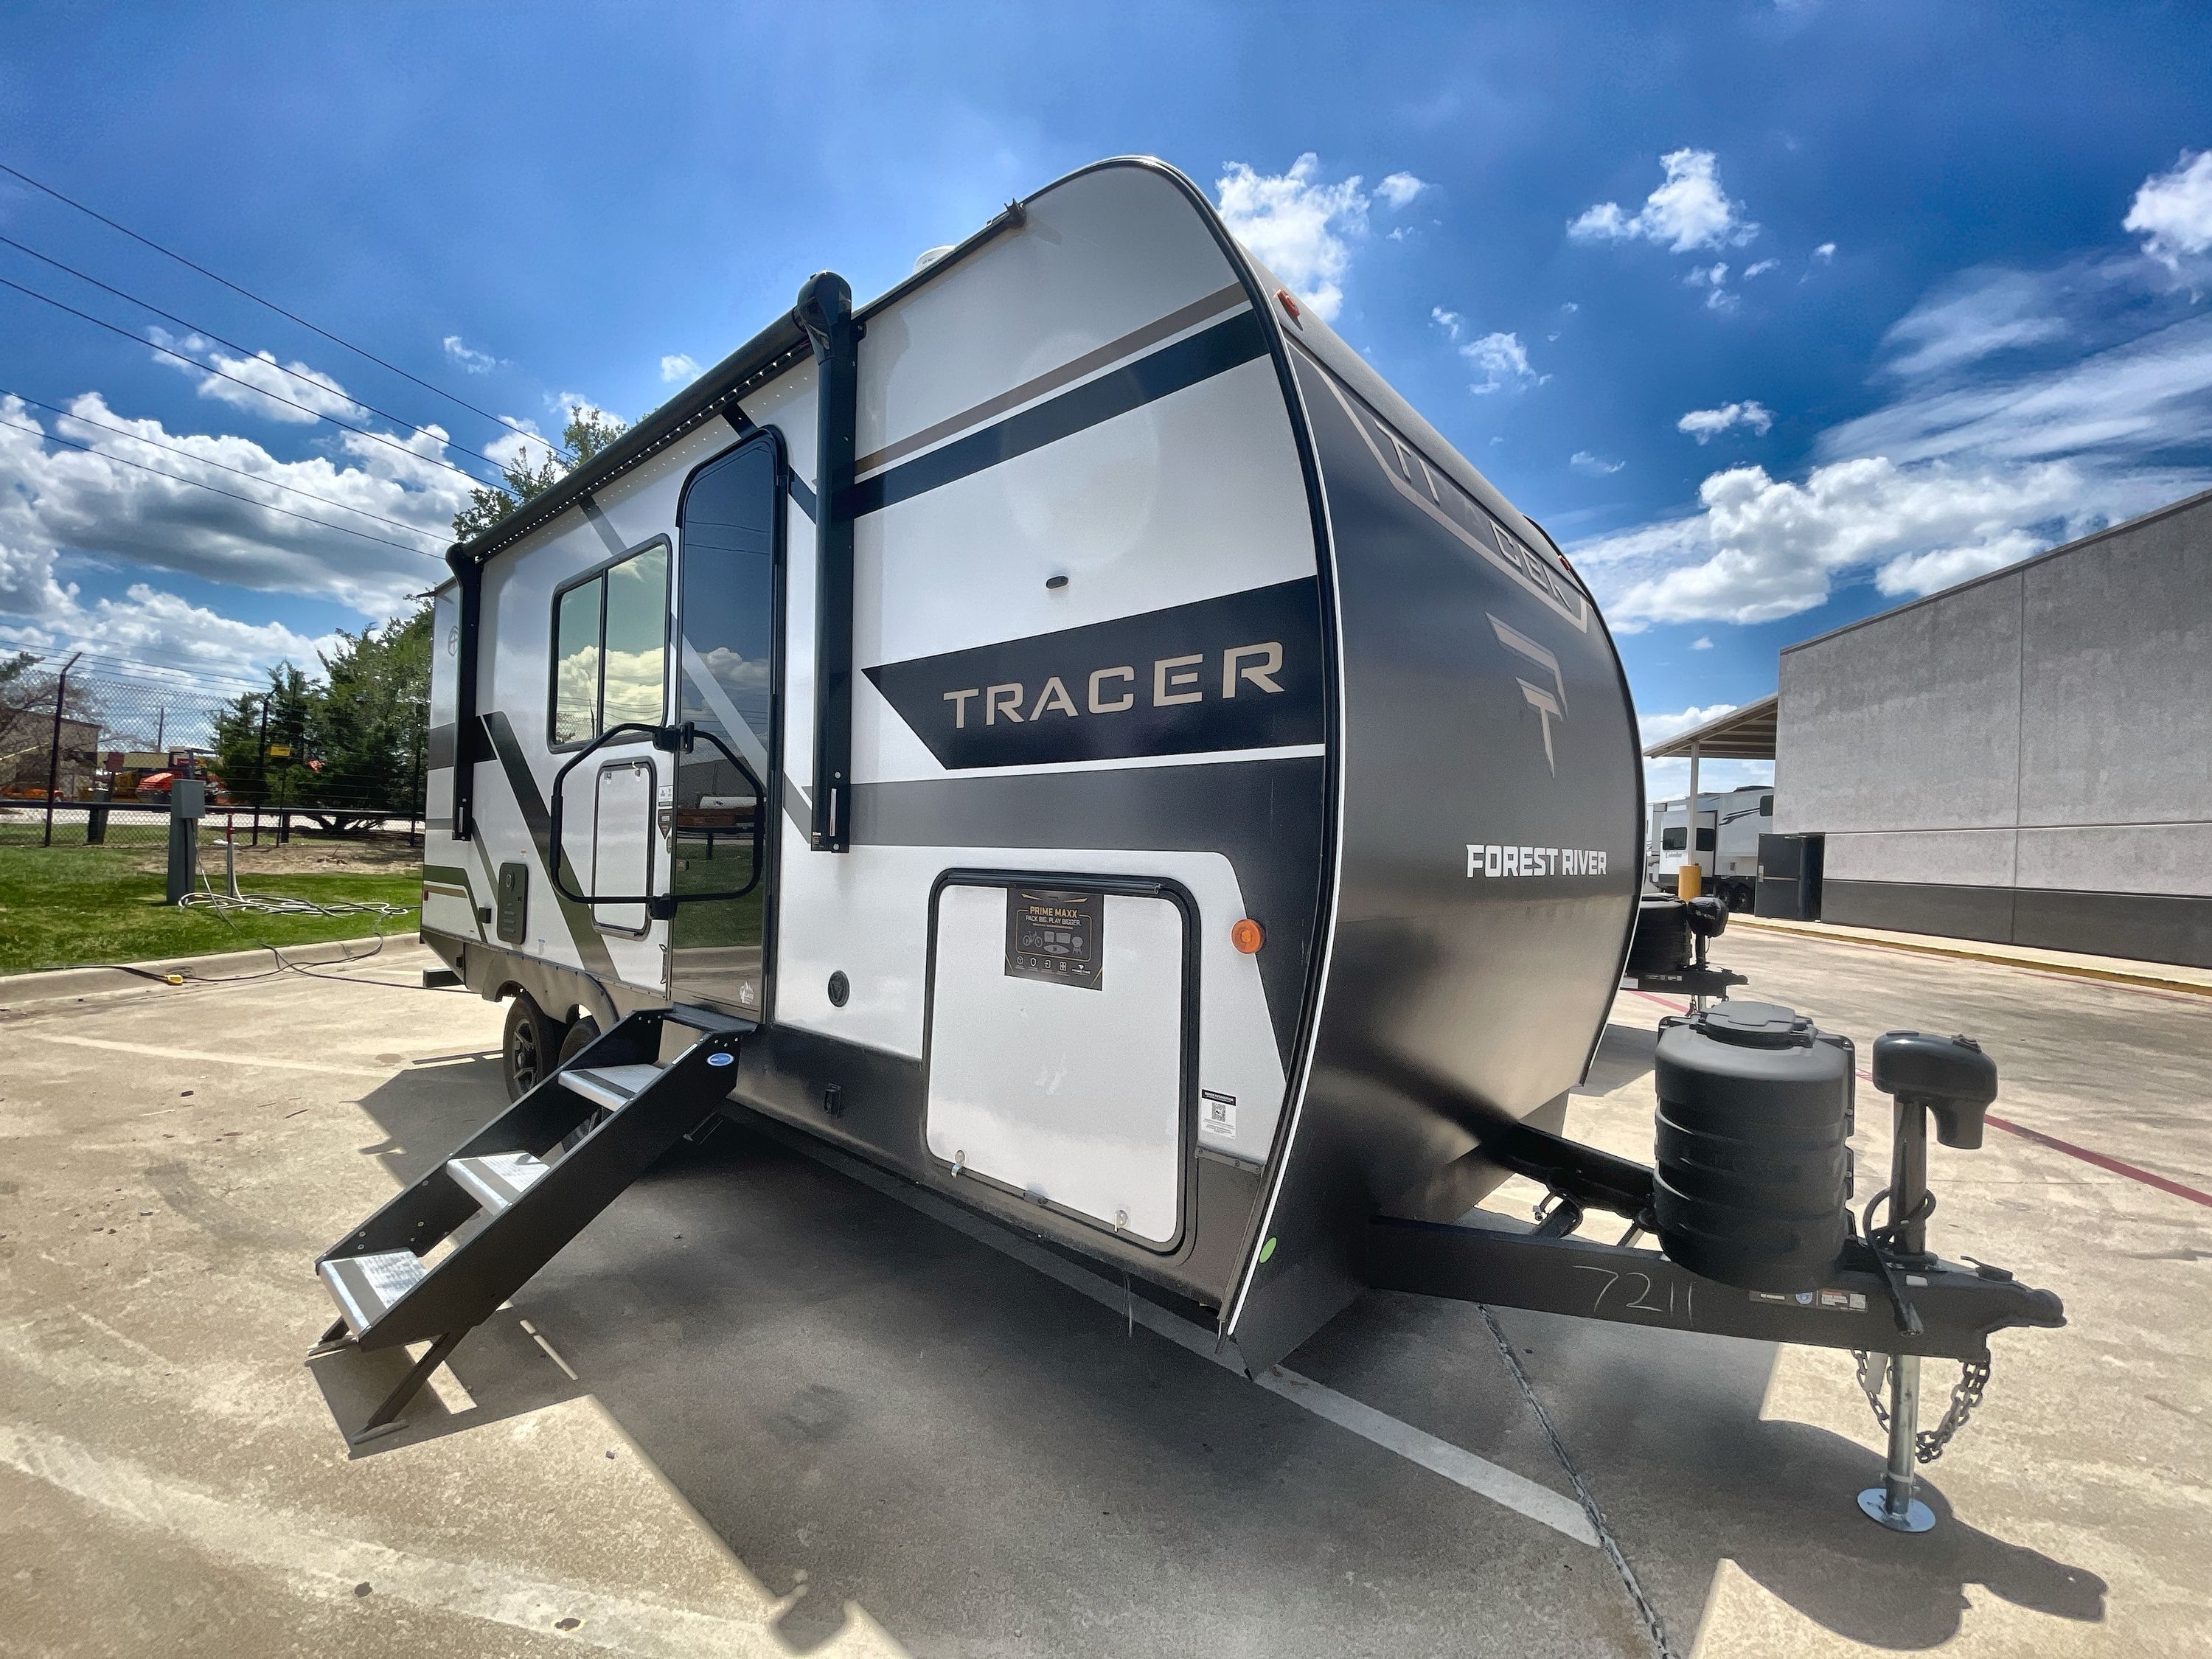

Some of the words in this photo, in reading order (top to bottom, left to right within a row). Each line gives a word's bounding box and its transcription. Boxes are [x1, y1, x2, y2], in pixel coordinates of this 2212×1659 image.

[1374, 419, 1572, 612] TCER
[942, 641, 1286, 729] TRACER
[1466, 844, 1559, 878] FOREST
[1561, 848, 1607, 877] RIVER
[1025, 914, 1038, 922] PACK
[1048, 917, 1062, 925] PLAY
[1029, 905, 1054, 917] PRIME
[1054, 908, 1078, 919] MAXX
[1571, 1265, 1693, 1323] 7211
